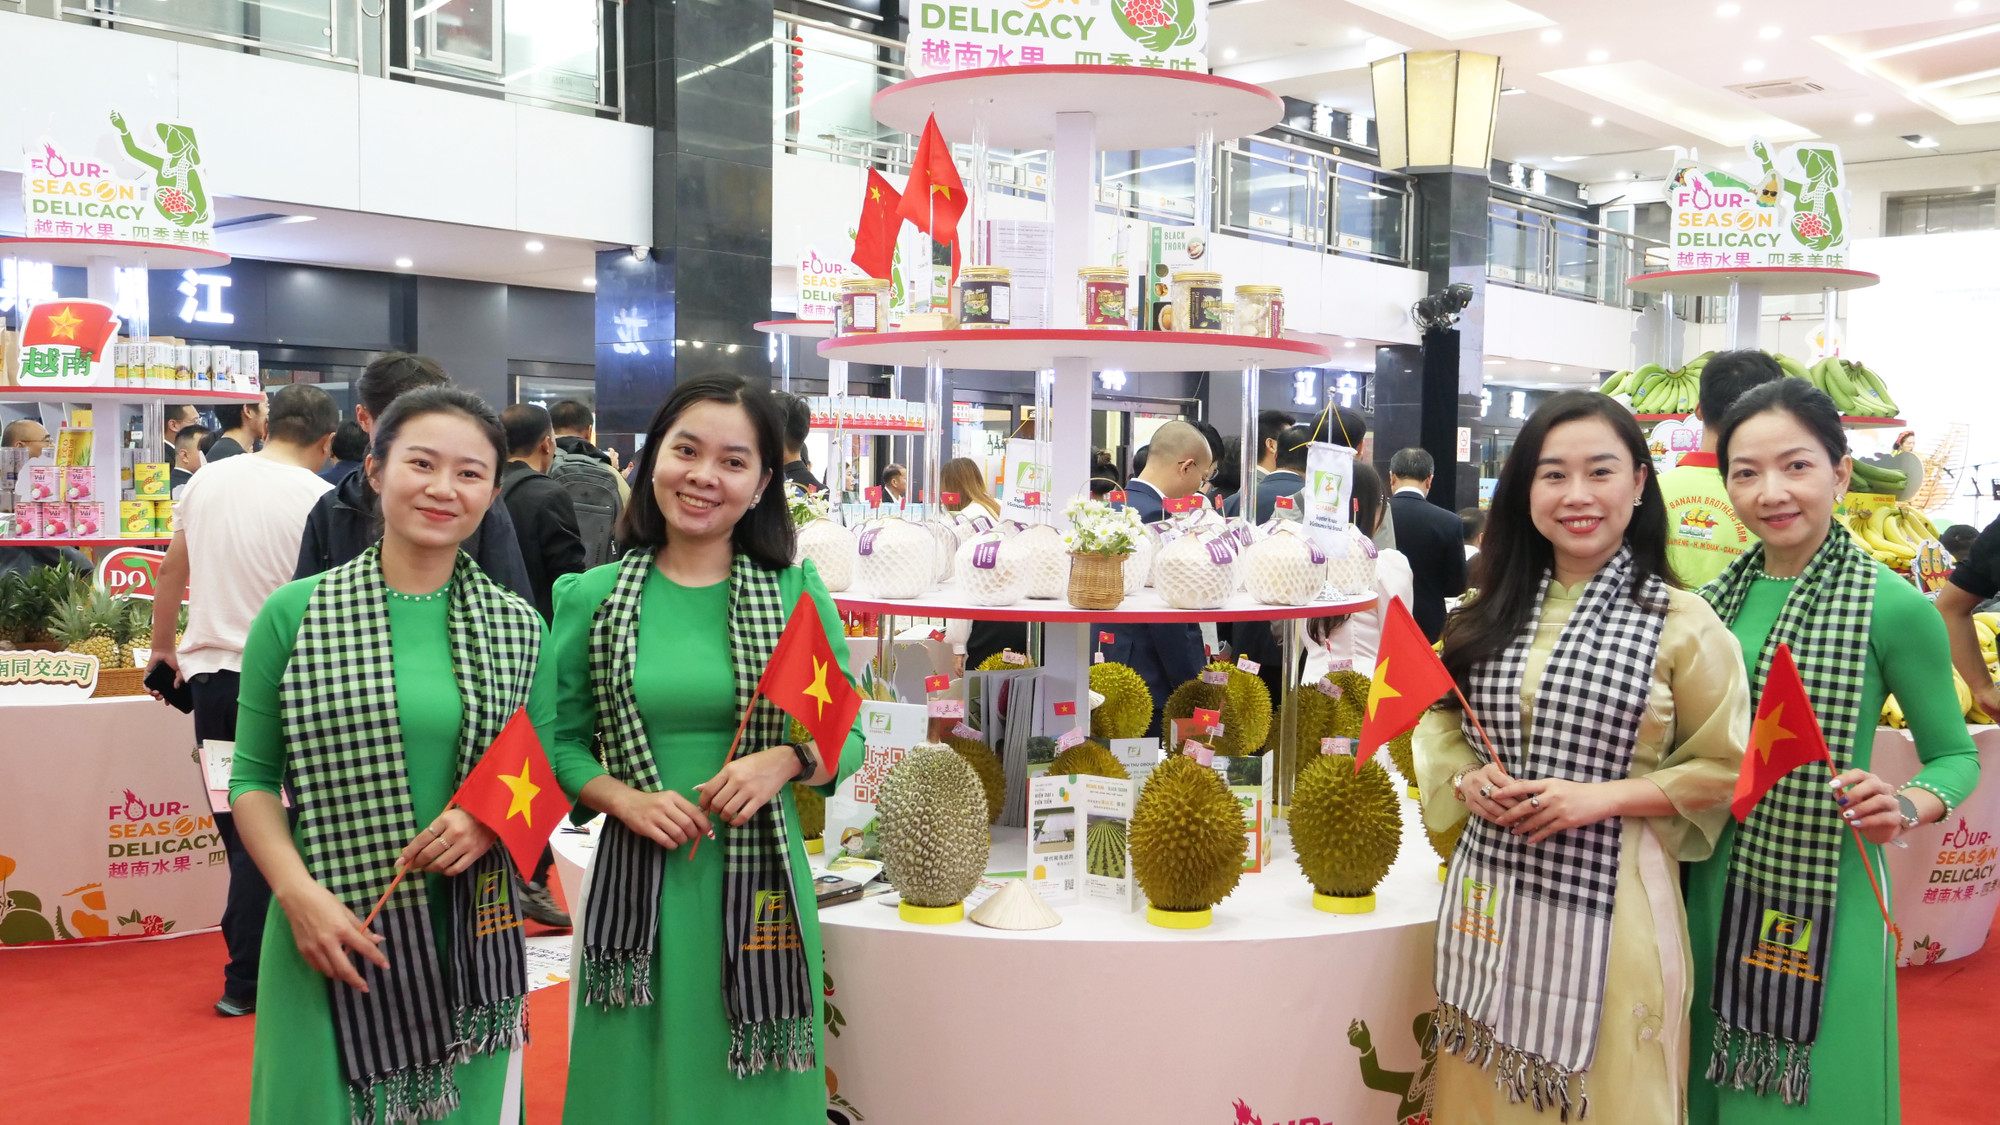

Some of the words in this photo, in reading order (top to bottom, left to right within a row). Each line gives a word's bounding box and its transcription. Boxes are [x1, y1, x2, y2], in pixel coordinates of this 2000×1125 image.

[921, 3, 1096, 41] DELICACY
[921, 39, 1045, 68] 越南水果
[31, 142, 109, 178] FOUR-
[32, 179, 134, 203] SEASON
[1678, 176, 1750, 210] FOUR-
[33, 199, 145, 220] DELICACY
[1678, 209, 1772, 231] SEASON
[35, 219, 114, 239] 越南水果
[133, 226, 210, 247] 四季美味
[1164, 231, 1186, 240] BLACK
[1677, 232, 1781, 248] DELICACY
[802, 249, 847, 275] FOUR-
[1677, 252, 1751, 269] 越南水果
[1768, 253, 1844, 269] 四季美味
[803, 275, 844, 288] SEAS
[803, 304, 835, 318] 越南水
[20, 347, 97, 379] 越南
[1669, 496, 1701, 509] BANANA
[1704, 497, 1736, 522] BROTHERS
[1735, 522, 1747, 542] FARM
[109, 788, 189, 822] FOUR-
[109, 814, 213, 839] SEASON
[1942, 817, 1991, 849] FOUR-
[108, 833, 222, 858] DELICACY
[1936, 846, 1998, 867] SEASON
[108, 856, 191, 879] 越南水果
[1929, 864, 1995, 884] DELICACY
[1922, 885, 1975, 905] 越南水果
